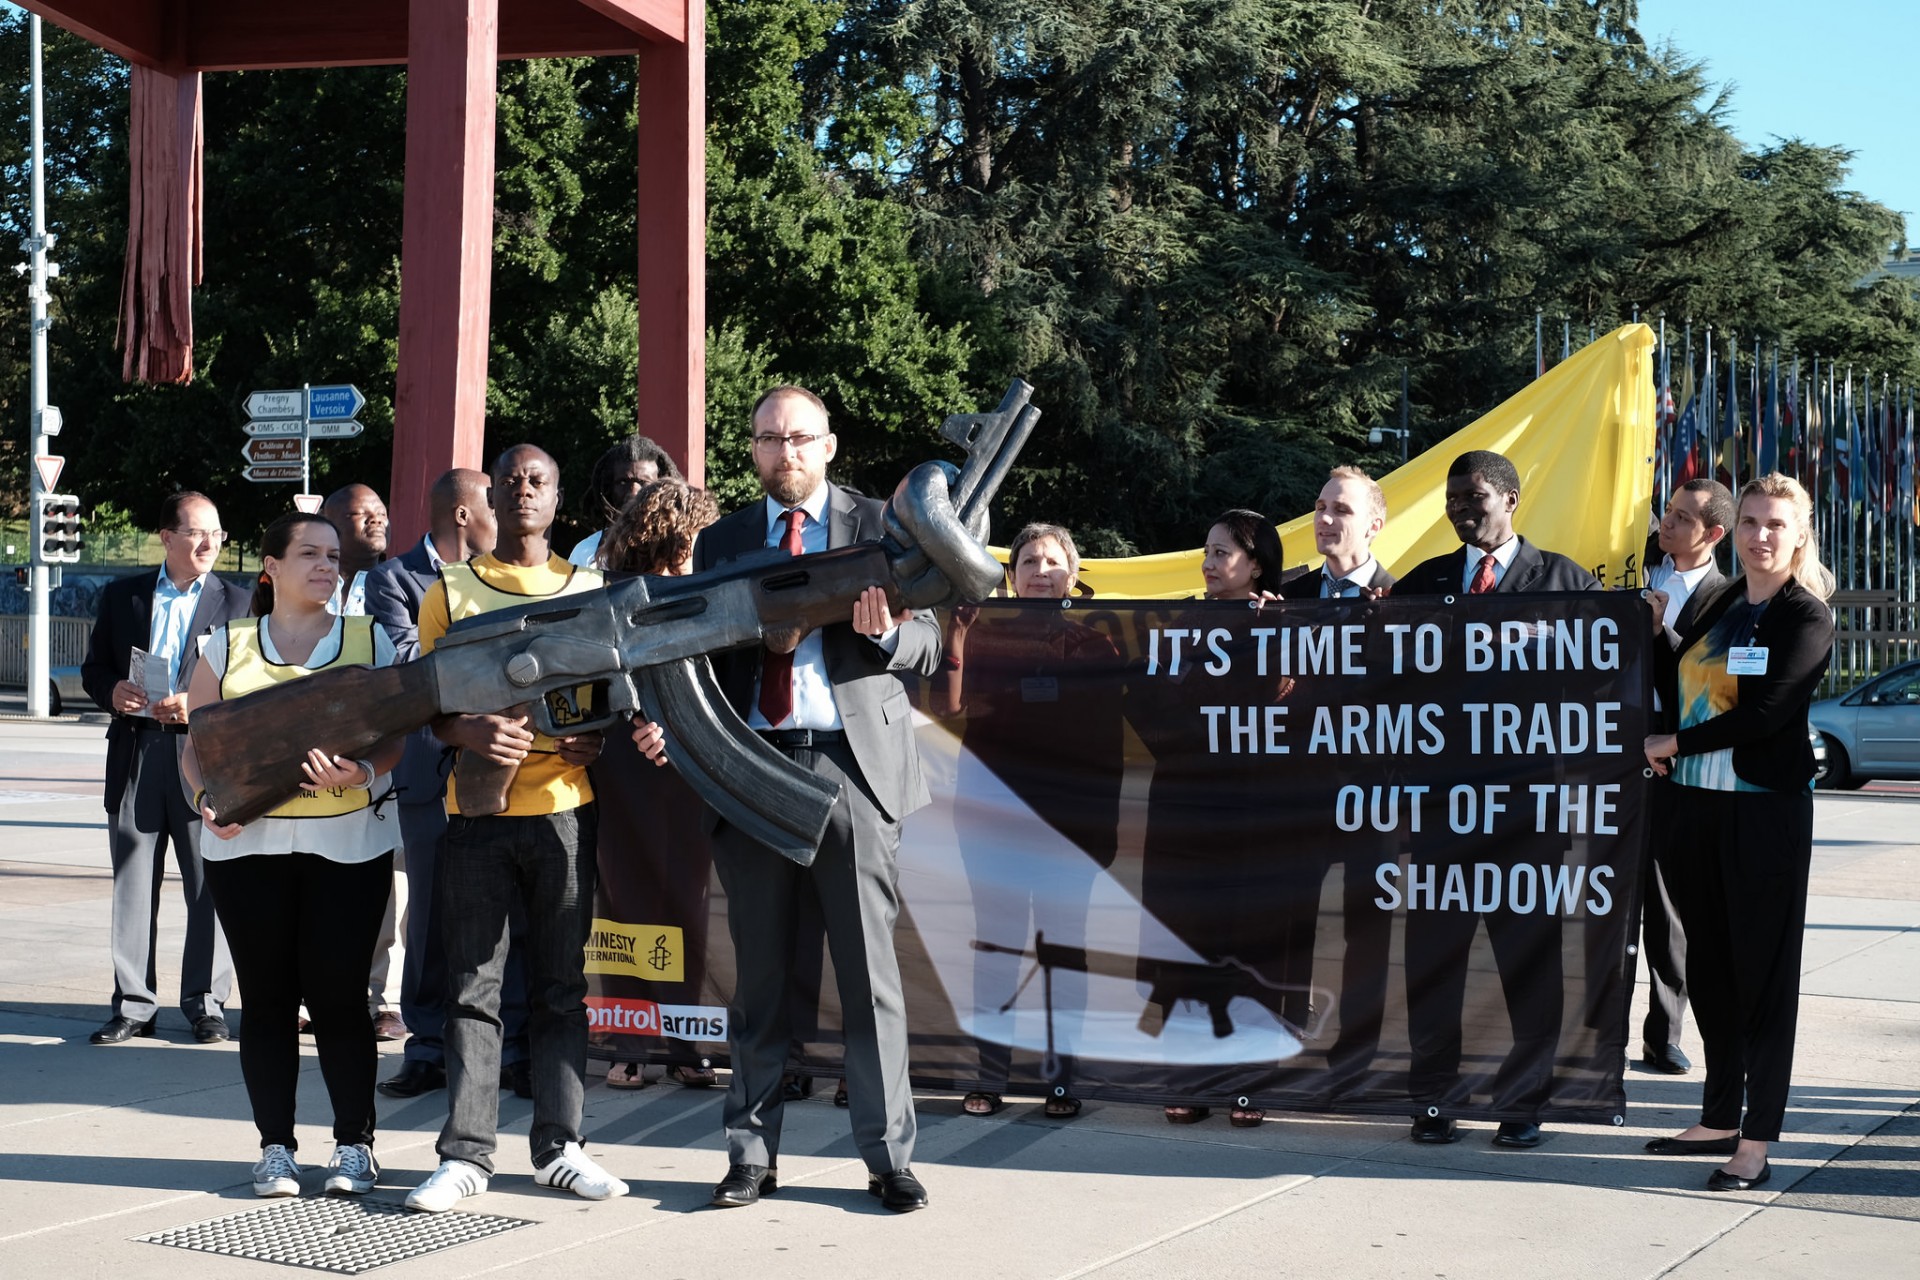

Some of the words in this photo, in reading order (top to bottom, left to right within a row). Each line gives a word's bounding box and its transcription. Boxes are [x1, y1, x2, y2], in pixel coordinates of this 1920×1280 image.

[263, 394, 289, 404] Pregny
[311, 391, 350, 402] Lausanne
[258, 405, 295, 415] Chambésy
[315, 403, 345, 415] Versoix
[258, 423, 275, 433] OMS
[282, 422, 300, 431] CICR
[322, 425, 340, 434] OMM
[1147, 627, 1232, 676] IT'S
[1251, 625, 1367, 676] TIME
[1385, 623, 1443, 675] TO
[1466, 618, 1620, 672] BRING
[1200, 706, 1290, 754] THE
[1308, 703, 1445, 755] ARMS
[1463, 702, 1623, 755] TRADE
[1336, 785, 1429, 833] OUT
[1449, 785, 1510, 834] OF
[1529, 784, 1621, 835] THE
[1375, 863, 1615, 916] SHADOWS
[586, 931, 636, 953] MNESTY
[585, 950, 637, 966] TERNATIONAL
[586, 1004, 657, 1030] ontrol
[663, 1015, 724, 1036] arms
